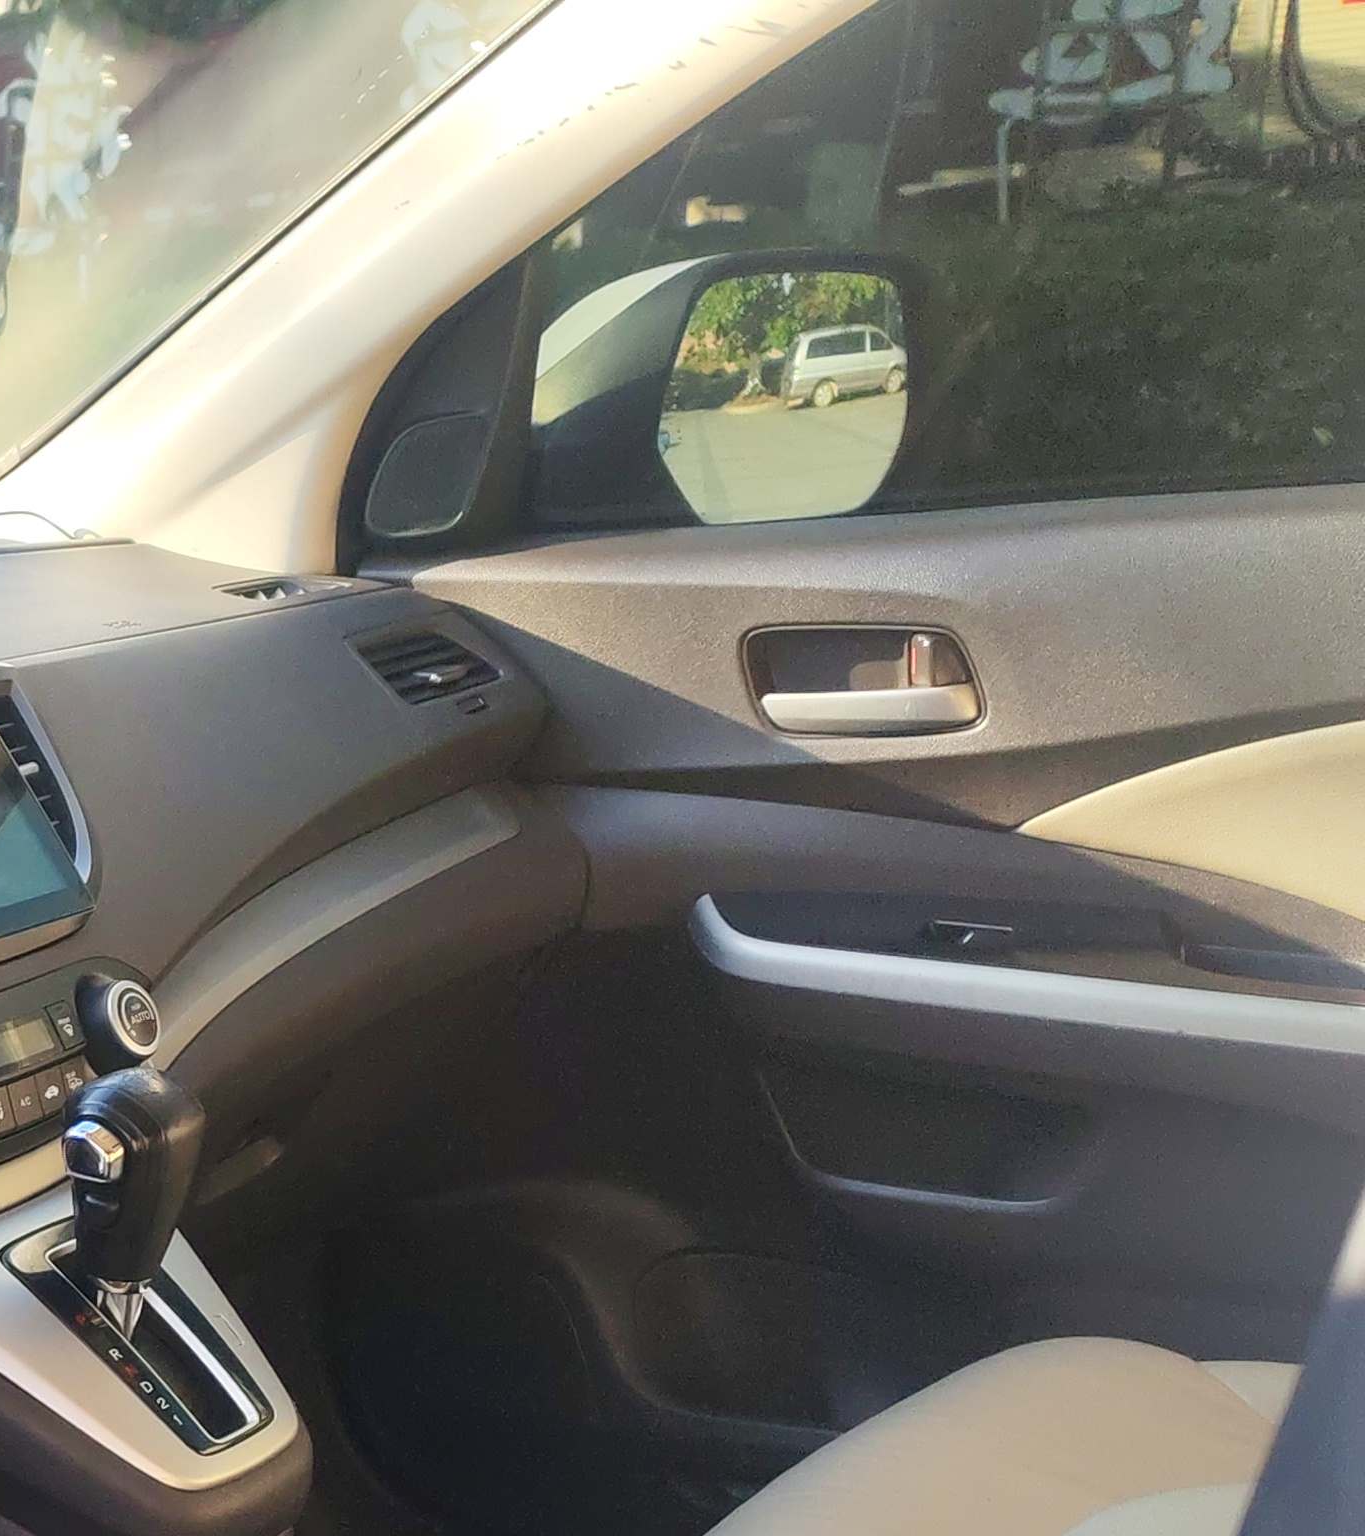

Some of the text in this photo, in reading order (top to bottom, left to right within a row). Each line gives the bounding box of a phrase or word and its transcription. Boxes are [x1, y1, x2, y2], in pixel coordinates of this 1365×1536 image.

[130, 1010, 151, 1025] AUTO
[108, 1347, 124, 1361] R
[139, 1381, 154, 1394] D
[156, 1396, 171, 1410] 2
